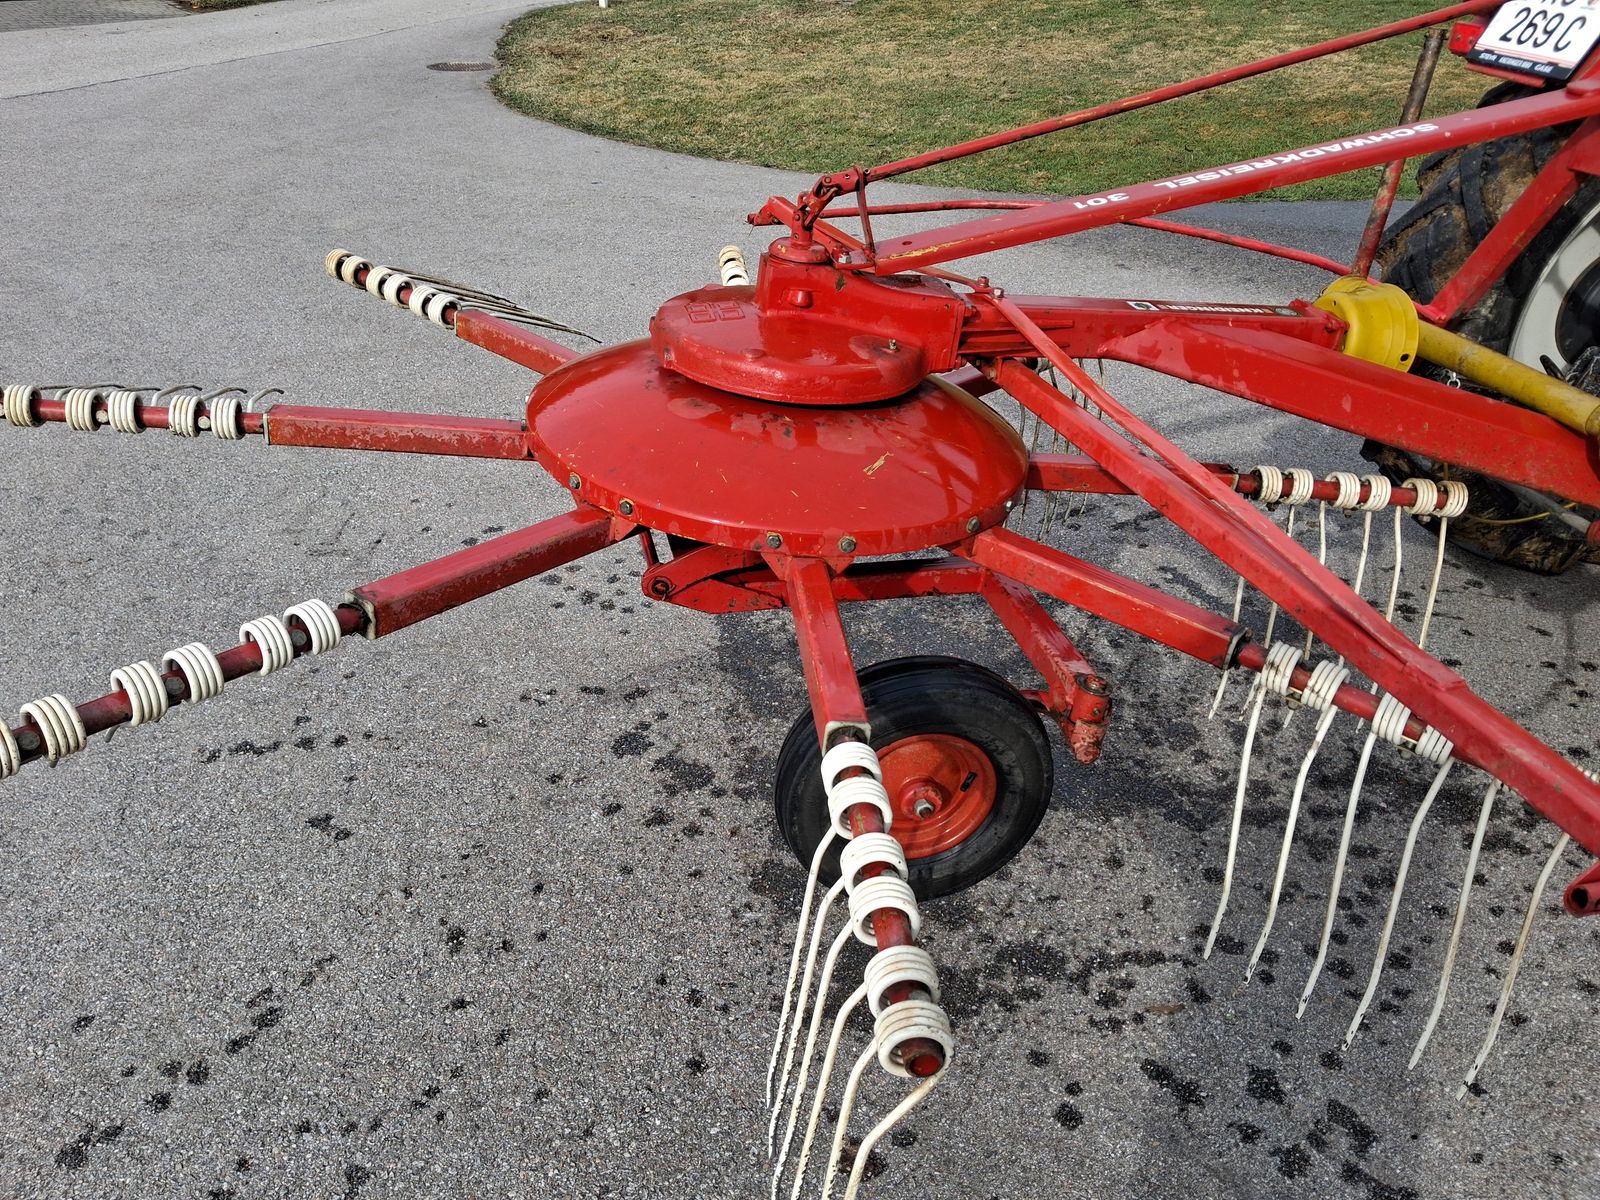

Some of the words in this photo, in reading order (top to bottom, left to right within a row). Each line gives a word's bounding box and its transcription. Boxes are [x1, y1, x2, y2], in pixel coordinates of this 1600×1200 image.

[1499, 8, 1587, 52] 269C
[1153, 123, 1439, 189] SCHWADKREISEL
[1074, 192, 1130, 209] 301
